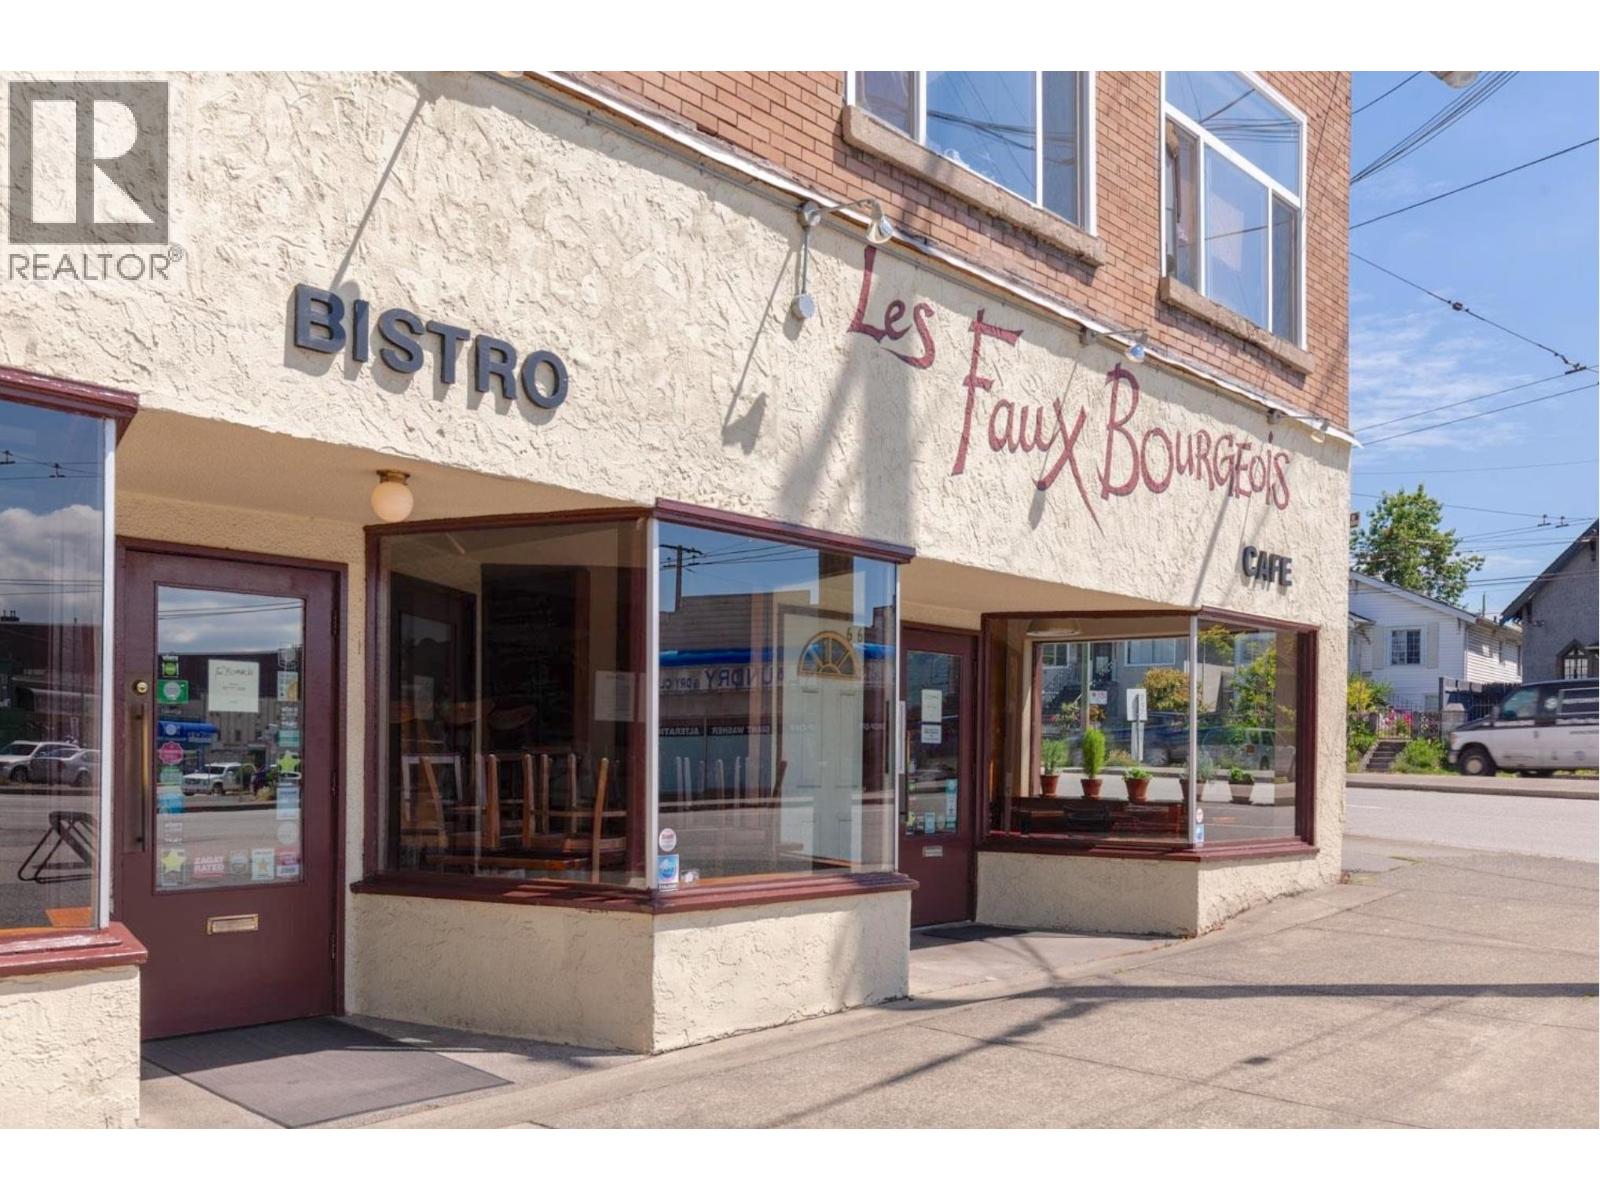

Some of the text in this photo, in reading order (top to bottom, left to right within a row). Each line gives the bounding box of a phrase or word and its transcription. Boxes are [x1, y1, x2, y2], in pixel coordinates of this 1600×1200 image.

[294, 283, 569, 409] BISTRO
[847, 245, 936, 370] Les
[951, 308, 1105, 537] Faux
[1242, 546, 1292, 587] CAFE
